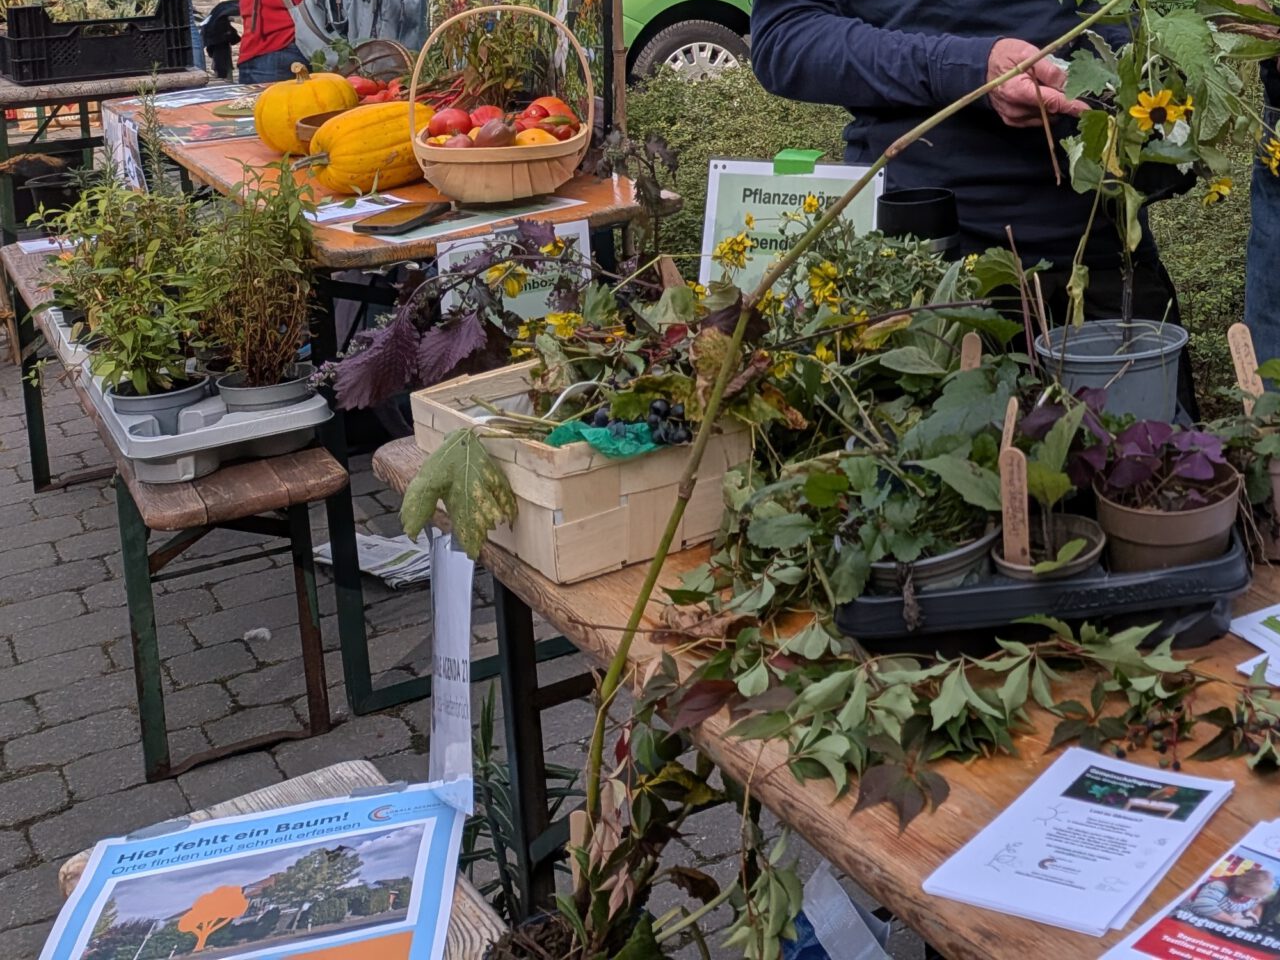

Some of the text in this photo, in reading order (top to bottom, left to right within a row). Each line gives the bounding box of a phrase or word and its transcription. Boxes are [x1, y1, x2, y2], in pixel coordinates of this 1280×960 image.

[111, 821, 361, 875] Orte finden und schnell erfassen
[117, 811, 350, 864] Hier fehlt ein Baum!
[1176, 909, 1262, 944] Wegwerfen?
